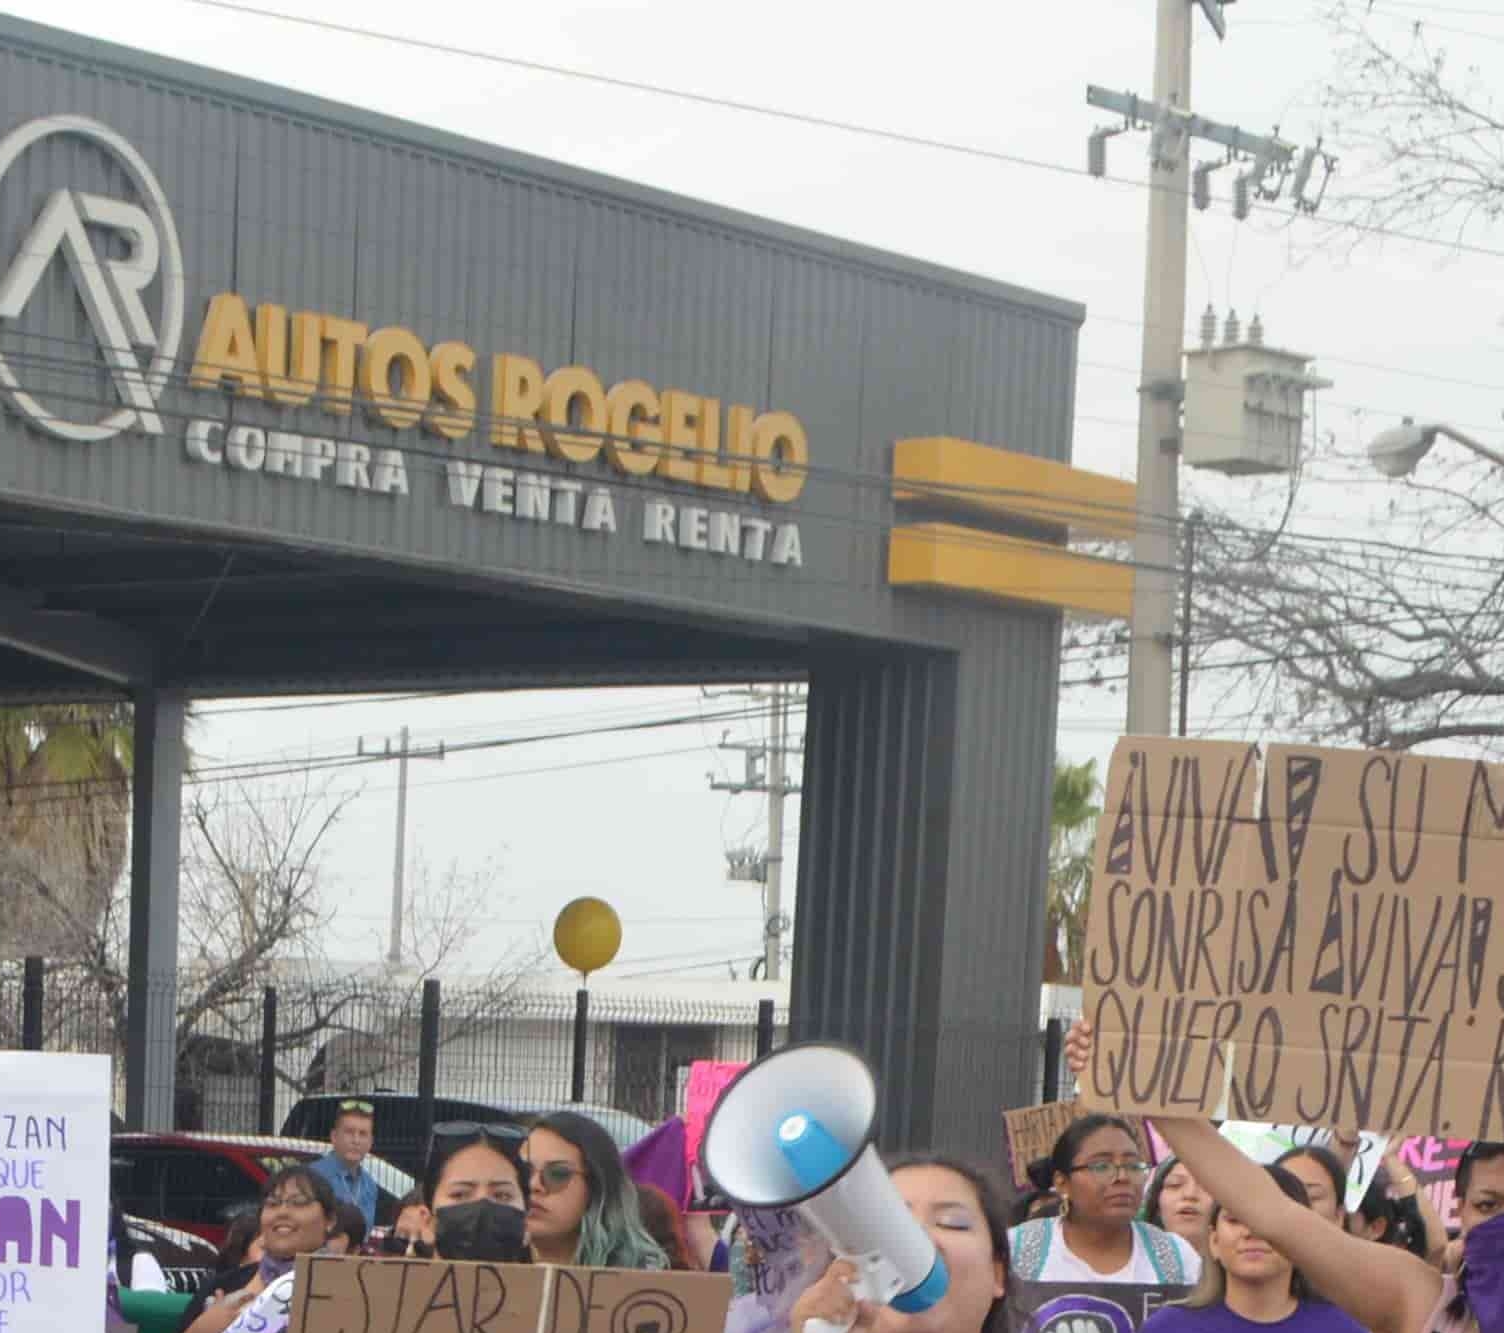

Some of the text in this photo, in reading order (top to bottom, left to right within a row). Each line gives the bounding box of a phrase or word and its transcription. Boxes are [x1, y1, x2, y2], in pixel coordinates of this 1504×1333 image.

[188, 289, 809, 503] AUTOS ROGELIO
[186, 417, 803, 569] COMPRA VENTA RENTA
[1342, 756, 1427, 886] SU
[1091, 879, 1298, 997] SONRISA
[1091, 988, 1283, 1120] QUIERO
